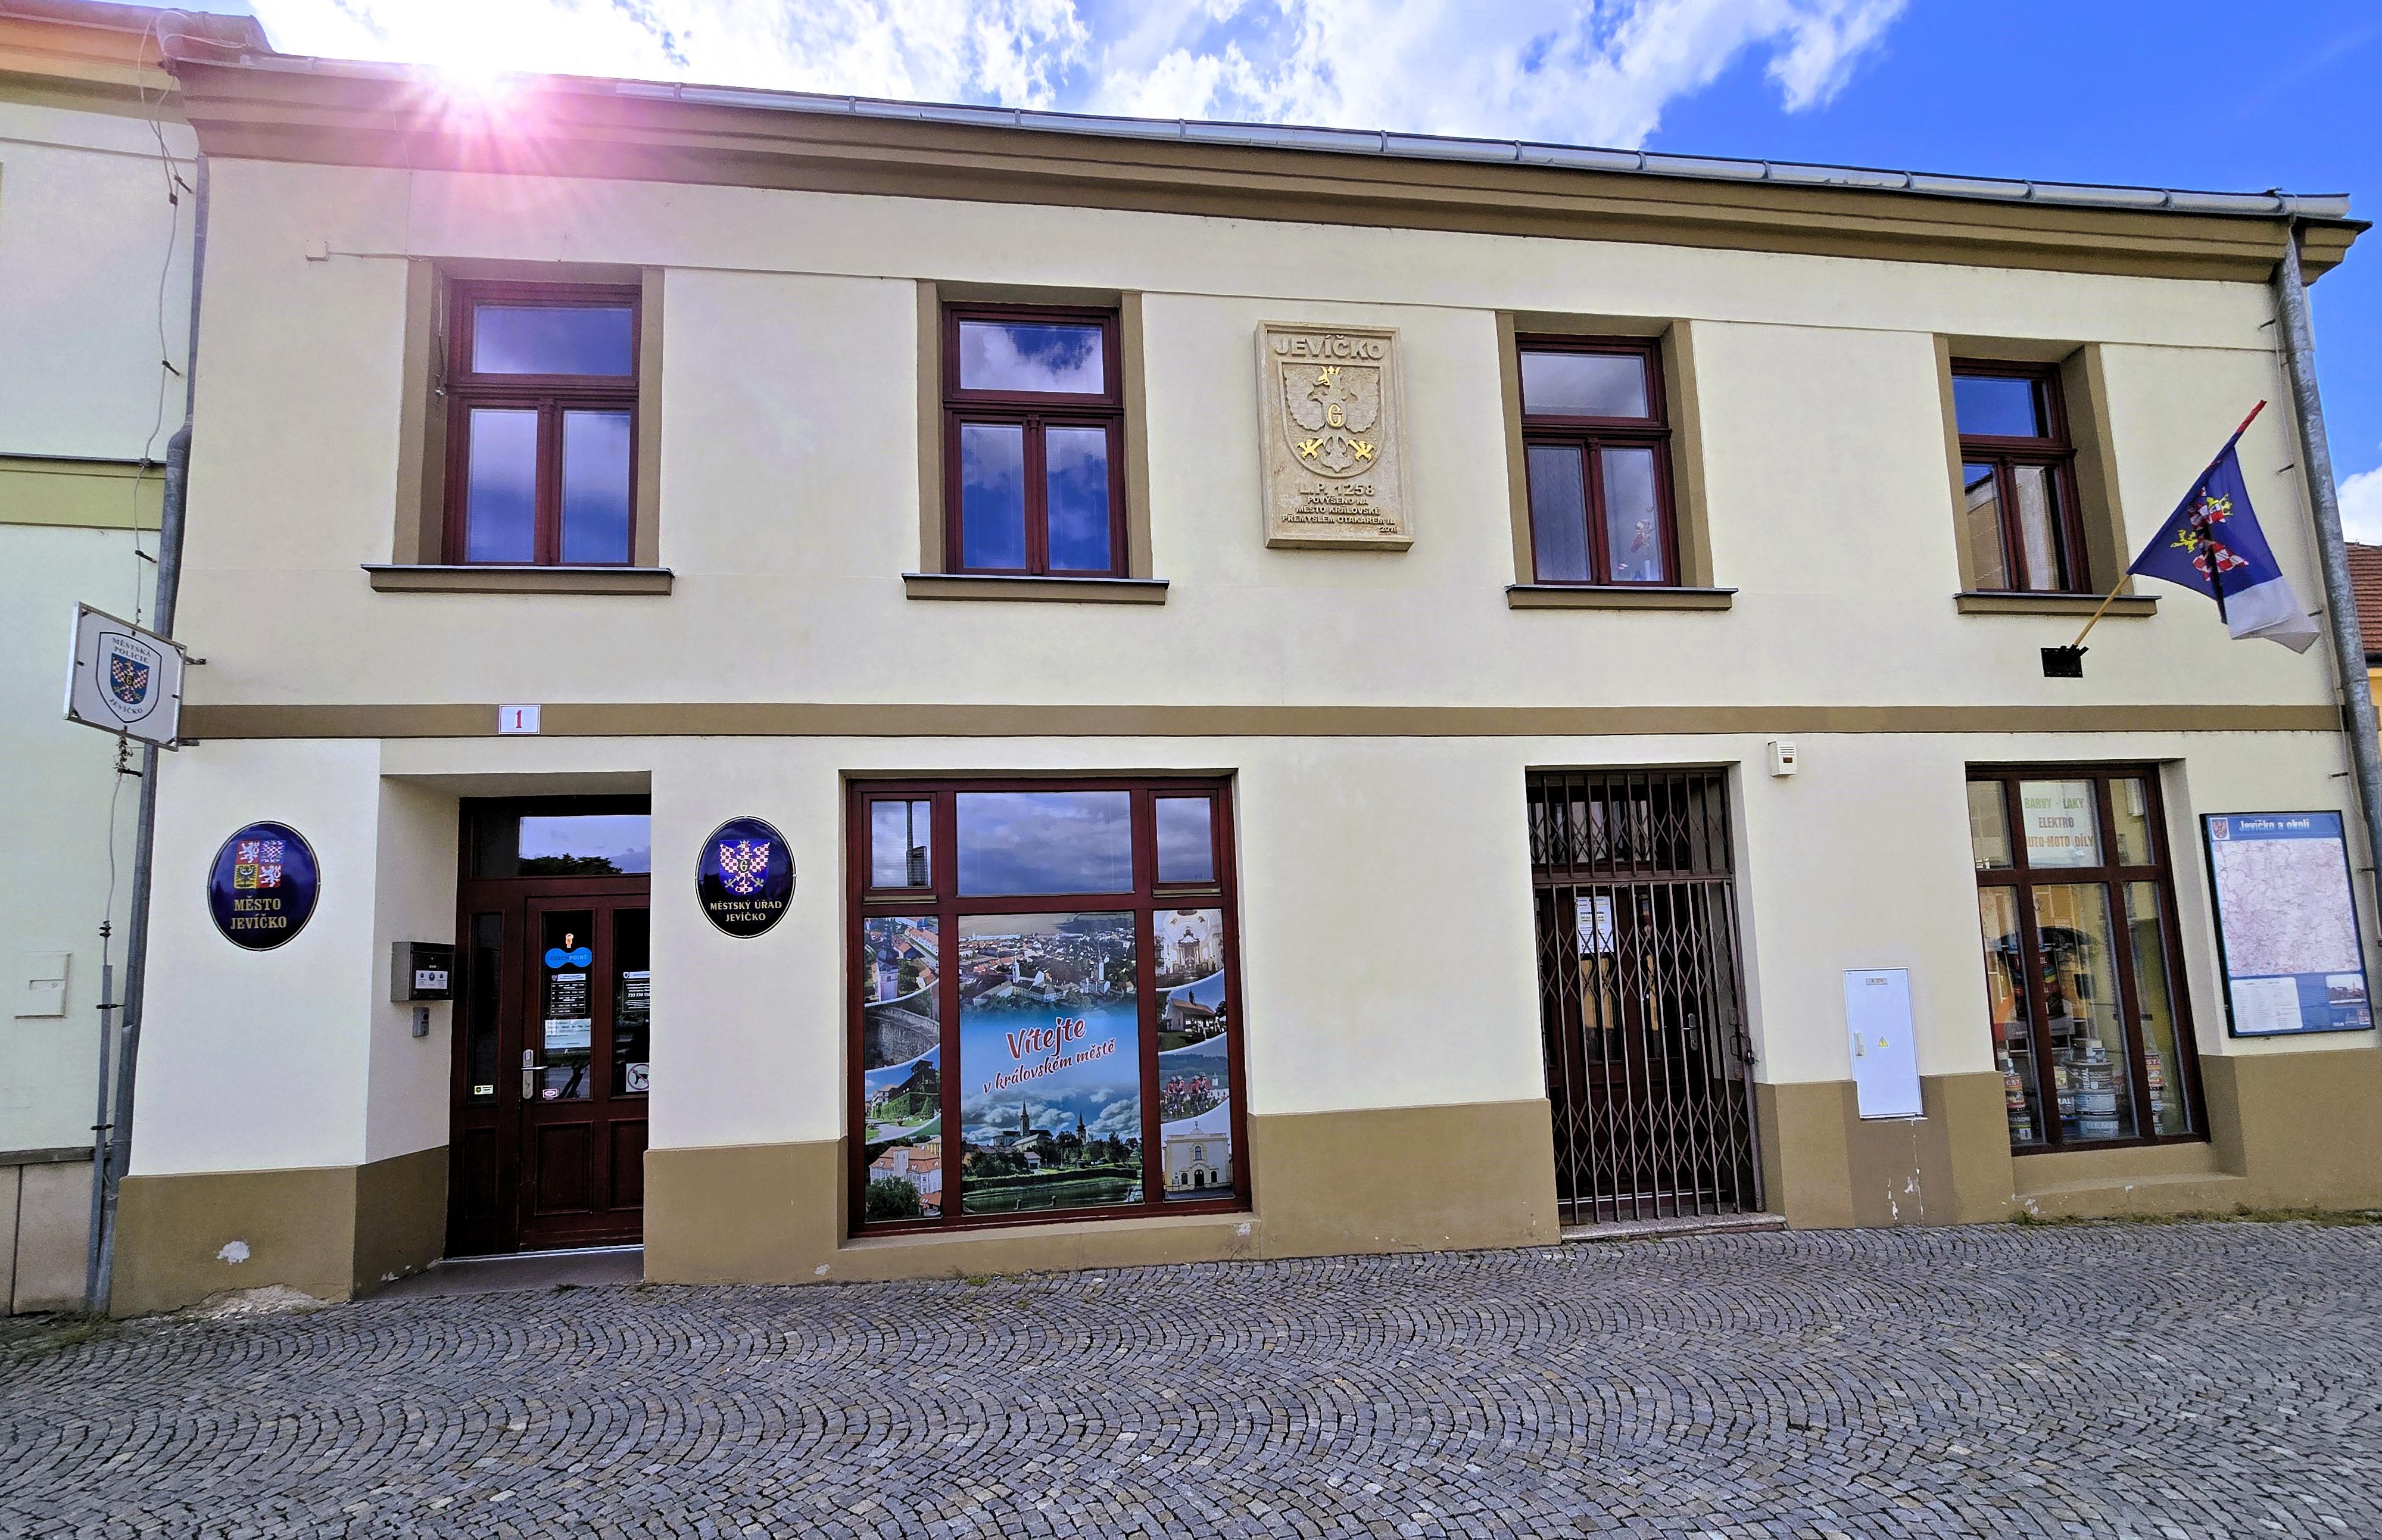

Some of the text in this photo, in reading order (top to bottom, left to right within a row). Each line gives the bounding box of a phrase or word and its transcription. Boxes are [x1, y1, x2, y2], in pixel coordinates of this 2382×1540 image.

[1274, 334, 1385, 360] JEVÍČKO
[1334, 484, 1374, 497] 1258
[1308, 496, 1354, 504] POVÝŠENO
[1296, 506, 1380, 516] MĚSTO KRÁLOVSKÉ
[1337, 516, 1384, 525] OTAKAREM
[114, 646, 149, 663] POLICIE
[516, 710, 522, 728] 1
[2063, 797, 2084, 809] LAKY
[2038, 816, 2075, 828] ELEKTRO
[2239, 819, 2275, 832] Jevíčko
[2277, 822, 2284, 830] a
[233, 896, 281, 911] MĚSTO
[710, 900, 782, 910] MĚSTSKÝ ÚŘAD
[230, 913, 287, 930] JEVÍČKO
[726, 912, 766, 922] JEVÍČKO
[1006, 1017, 1086, 1059] Vítejte
[983, 1038, 1116, 1094] v královském městě
